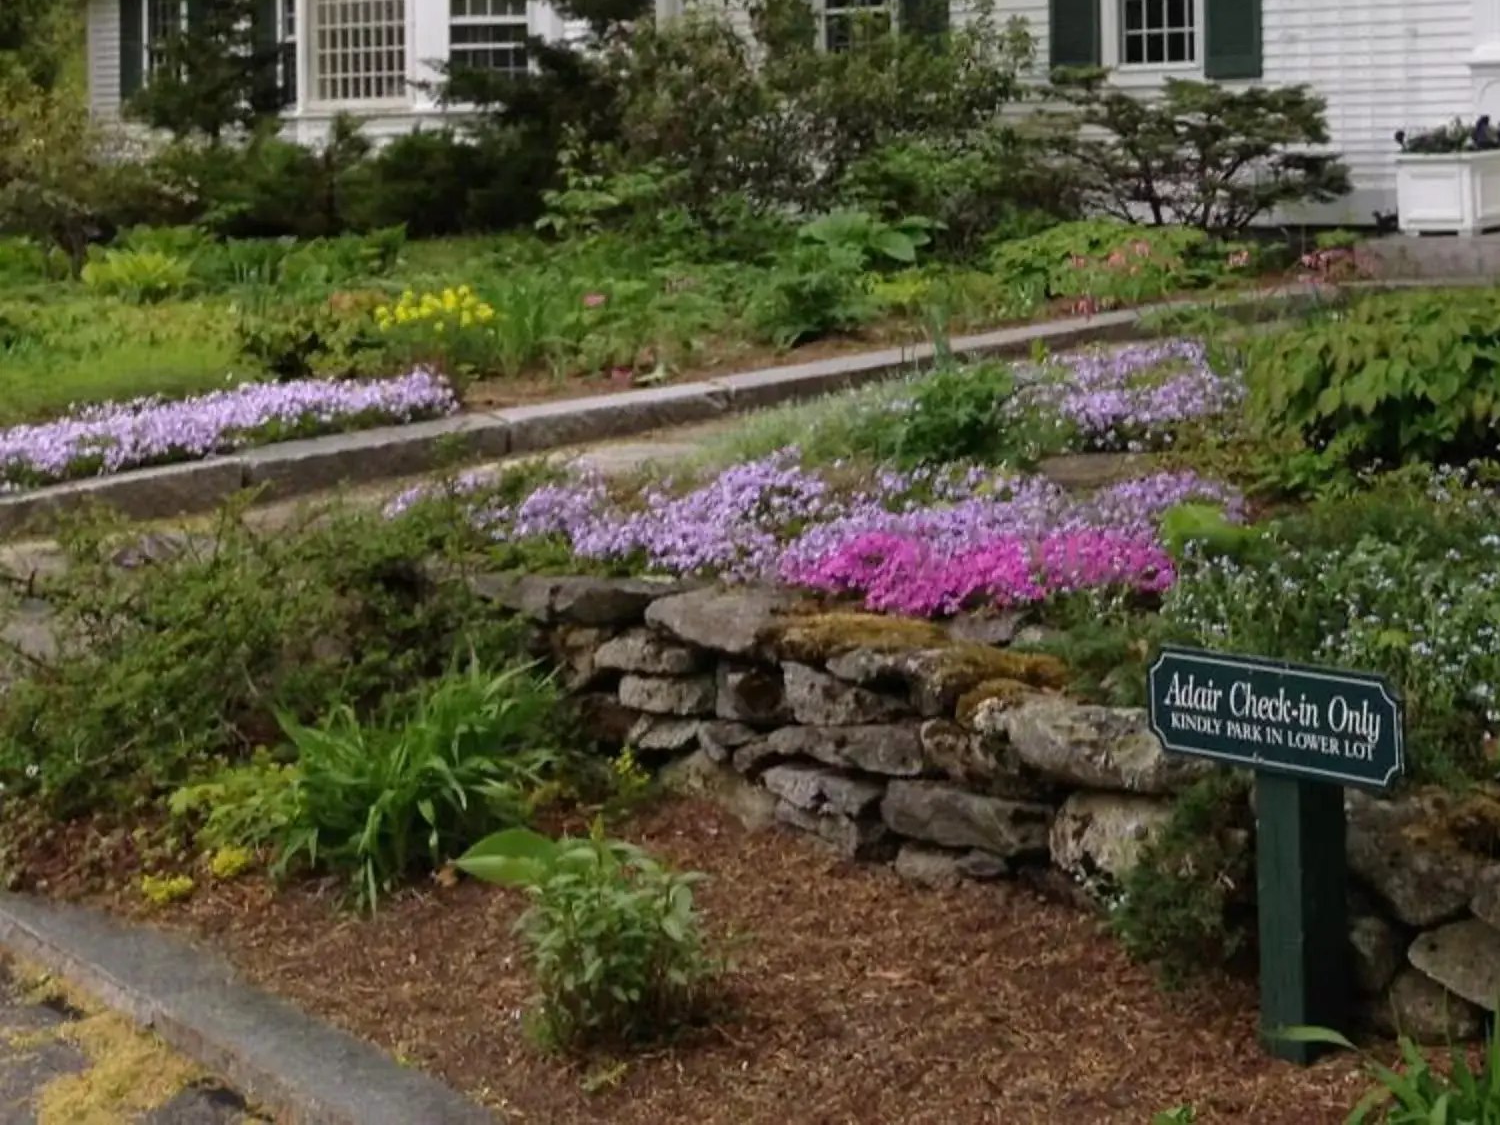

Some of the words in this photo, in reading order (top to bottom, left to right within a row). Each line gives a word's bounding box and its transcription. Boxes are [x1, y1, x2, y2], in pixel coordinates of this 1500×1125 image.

[1163, 671, 1223, 712] Adair
[1229, 681, 1319, 727] Check-in
[1328, 695, 1381, 743] Only
[1171, 711, 1224, 735] KINDLY
[1227, 720, 1262, 742] PARK
[1265, 726, 1283, 745] IN
[1287, 730, 1340, 756] LOWER
[1344, 739, 1376, 761] LOT
